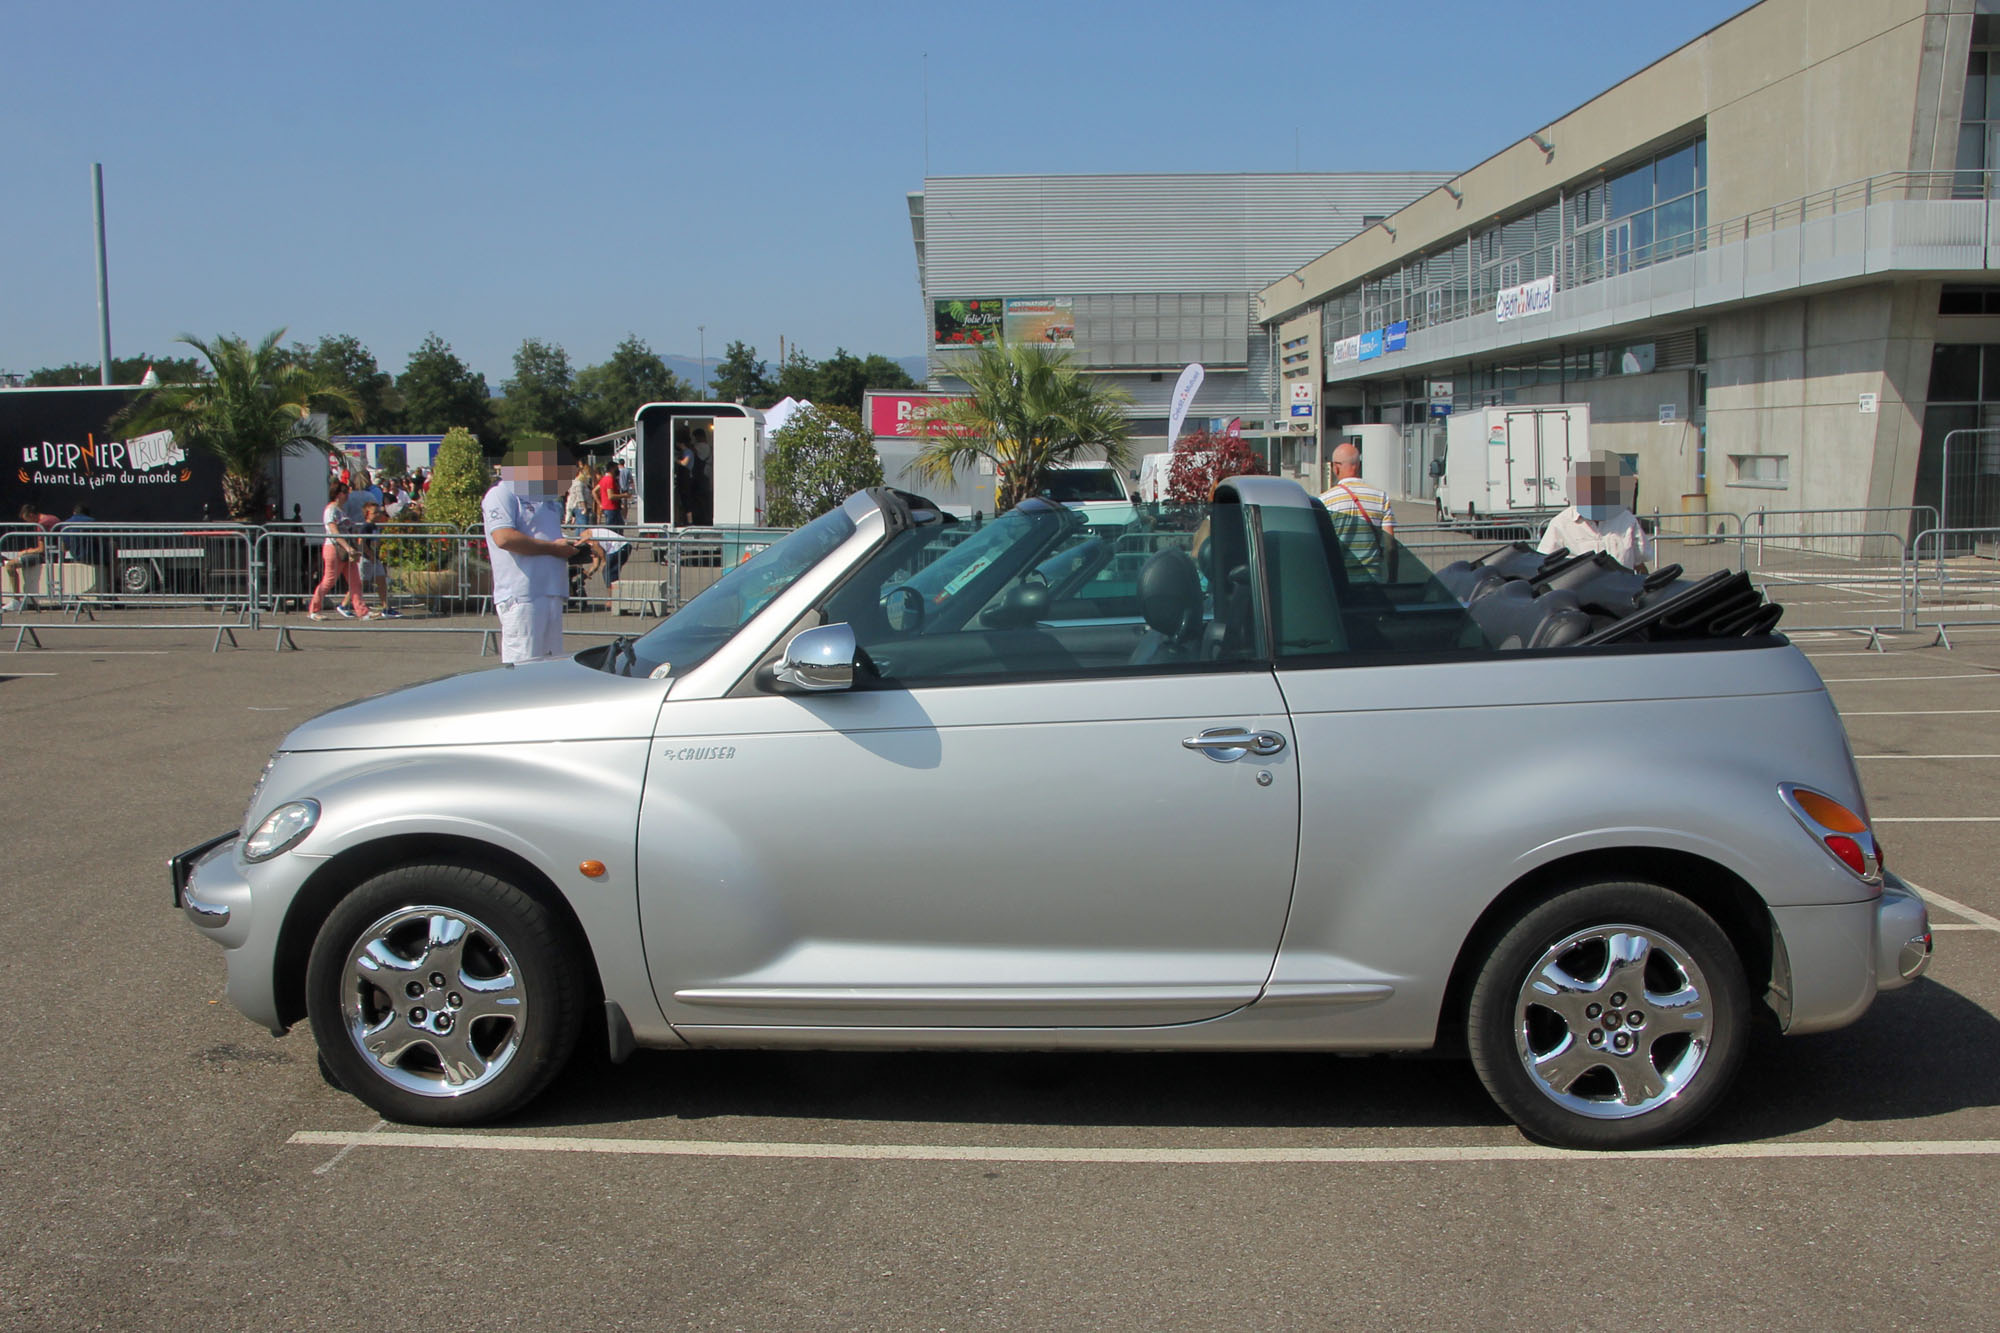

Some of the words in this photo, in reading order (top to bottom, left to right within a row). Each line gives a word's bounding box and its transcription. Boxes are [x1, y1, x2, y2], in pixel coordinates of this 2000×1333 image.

[1498, 294, 1518, 319] Crédit
[1526, 283, 1551, 313] Mutuel
[22, 446, 39, 463] LE
[42, 432, 125, 473] DERNIER
[128, 433, 181, 468] TRUCK
[34, 471, 71, 486] Avant
[89, 473, 116, 490] faim
[120, 471, 135, 484] du
[138, 471, 177, 485] monde
[677, 746, 737, 761] CRUISER
